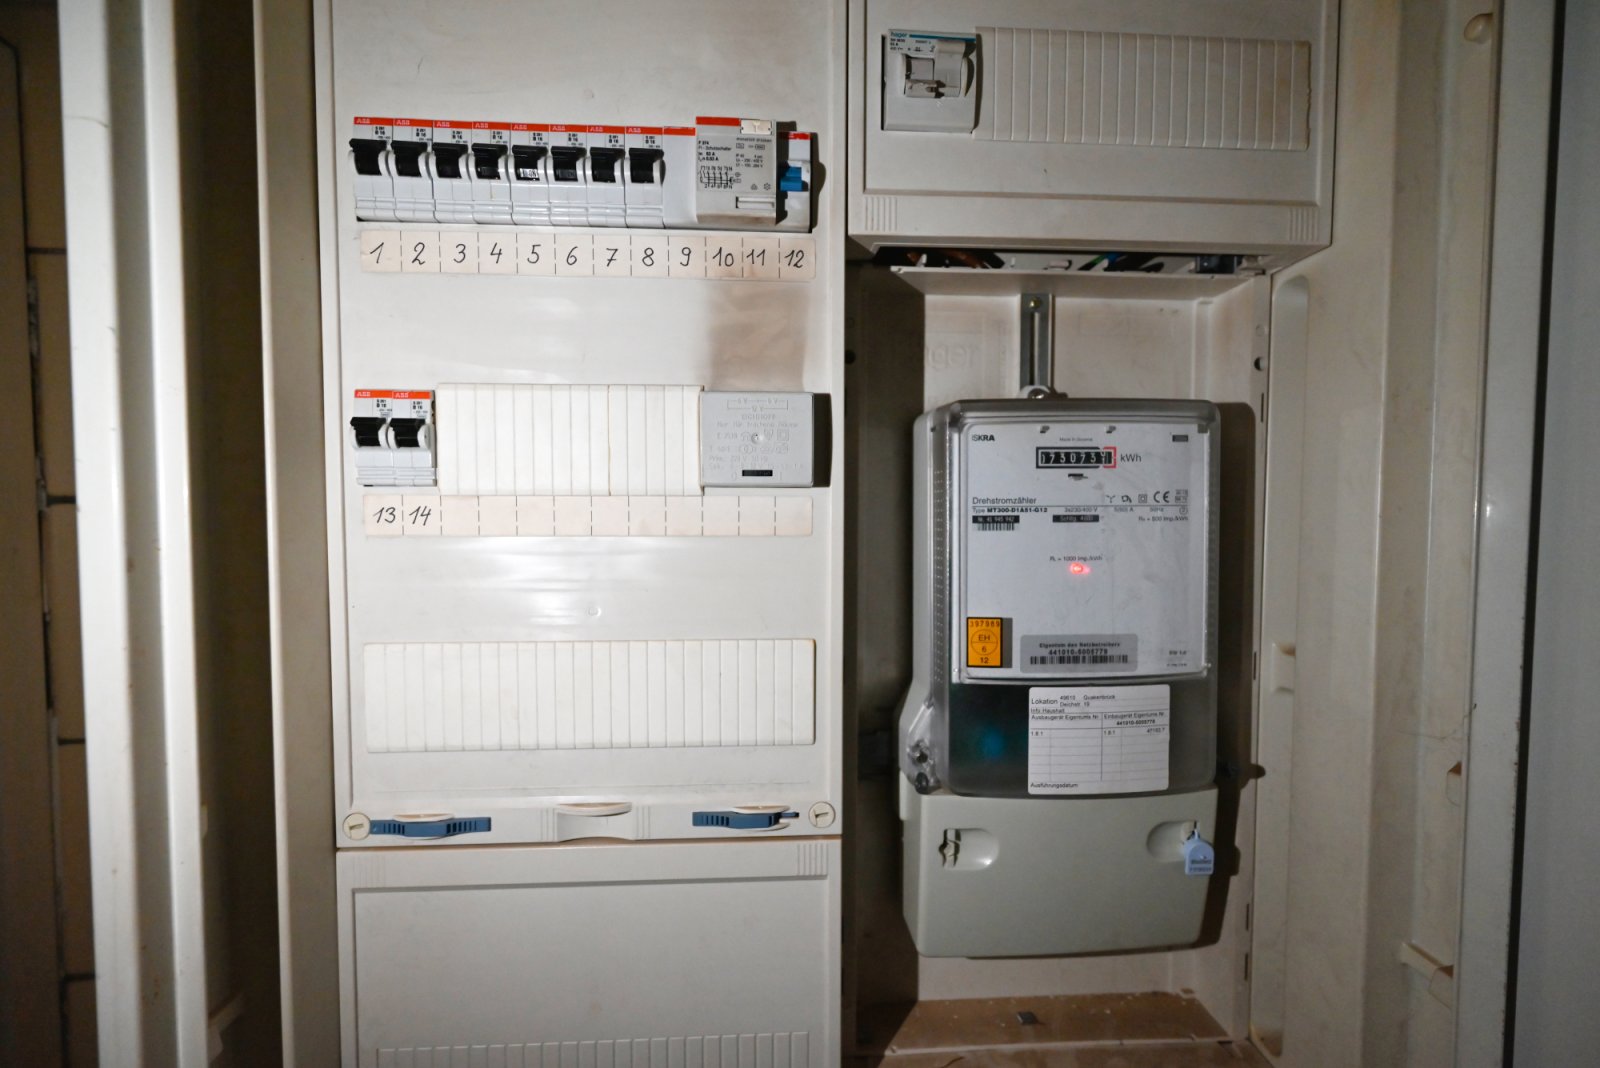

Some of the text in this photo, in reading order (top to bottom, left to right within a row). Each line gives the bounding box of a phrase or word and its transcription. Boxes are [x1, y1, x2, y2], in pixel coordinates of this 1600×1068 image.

[370, 242, 804, 268] 1 2 3 4 5 6 7 8 9 10 11 12
[1121, 454, 1142, 462] kWh
[373, 506, 431, 526] 13 14
